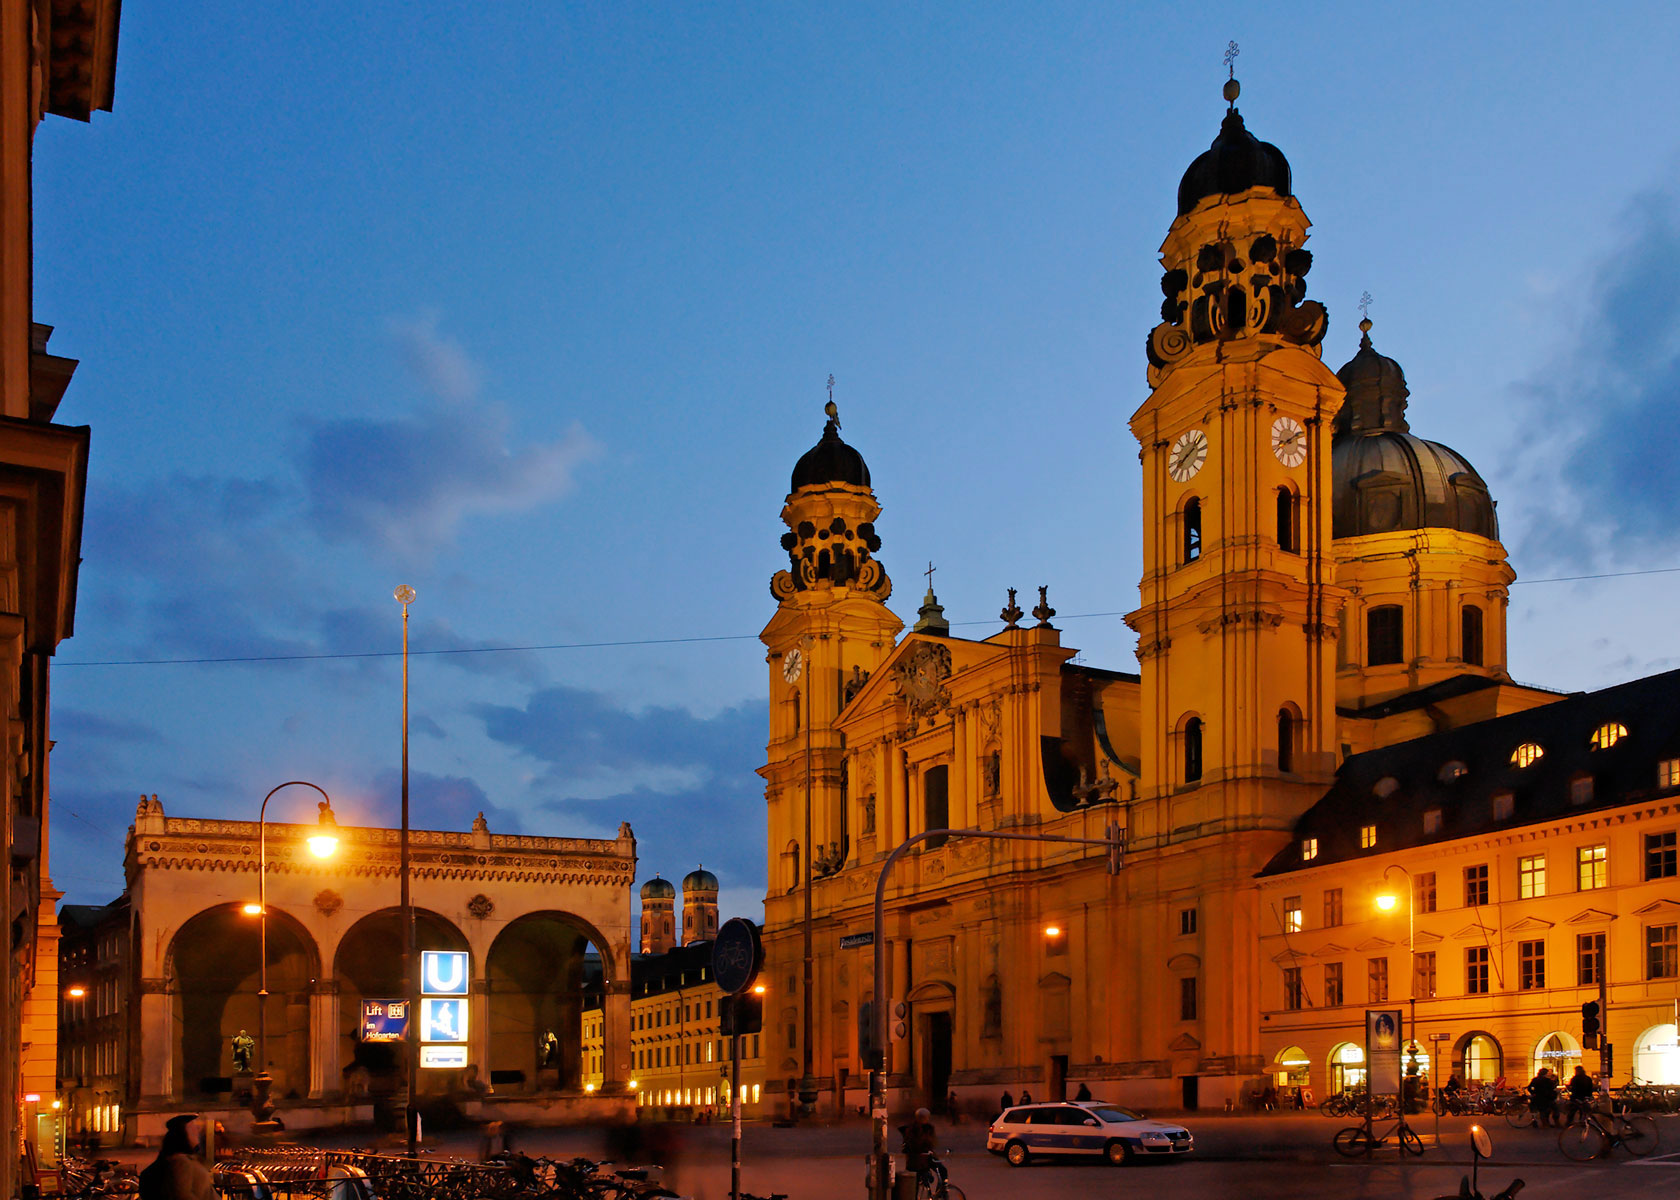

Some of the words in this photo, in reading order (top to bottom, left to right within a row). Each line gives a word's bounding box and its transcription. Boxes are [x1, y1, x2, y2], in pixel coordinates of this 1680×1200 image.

[427, 954, 463, 992] U
[366, 1005, 383, 1016] Lift
[366, 1022, 376, 1030] im
[366, 1031, 400, 1040] Hofgarten
